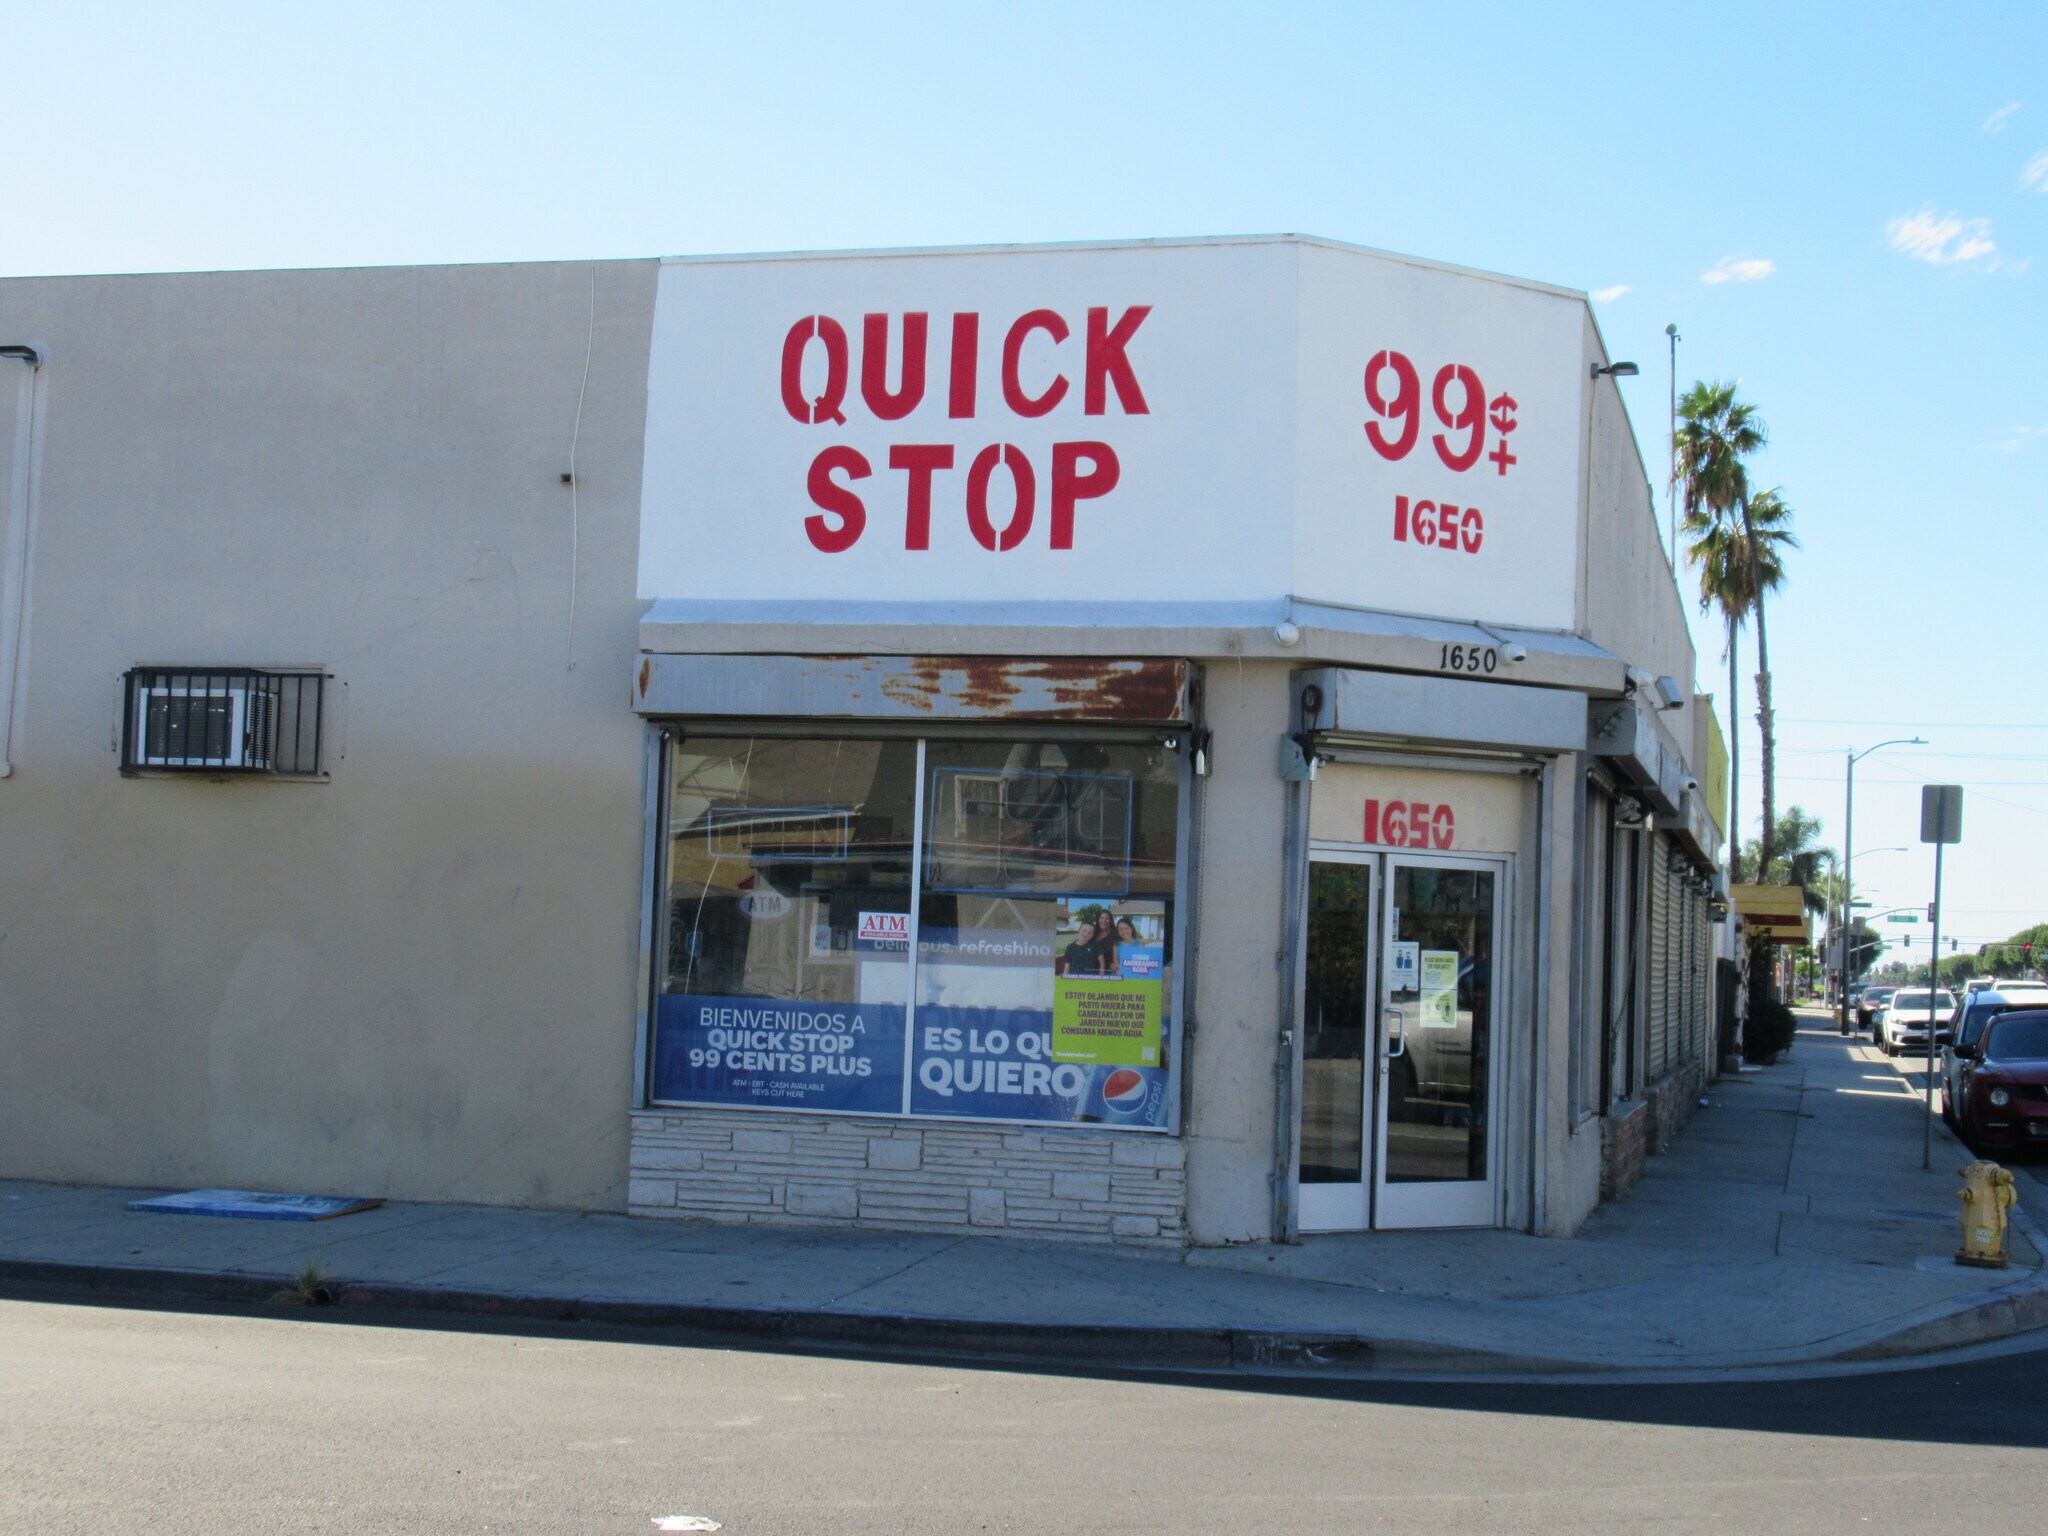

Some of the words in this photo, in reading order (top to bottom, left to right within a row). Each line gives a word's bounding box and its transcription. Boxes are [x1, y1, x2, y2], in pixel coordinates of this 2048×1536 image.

[780, 305, 1154, 427] QUICK
[804, 440, 1121, 553] STOP
[1393, 494, 1484, 554] 1650
[1440, 643, 1497, 673] 1650
[1363, 799, 1455, 850] 1650
[748, 896, 781, 912] ATM
[863, 914, 907, 931] ATM
[1065, 991, 1086, 1000] ESTOY
[1087, 992, 1119, 1001] DEJANDO
[1121, 994, 1134, 1002] QUE
[1078, 1001, 1100, 1009] PASTO
[1101, 1002, 1125, 1010] MUERA
[1127, 1003, 1145, 1011] PARA
[700, 1007, 846, 1033] BIENVENIDOS
[850, 1014, 866, 1034] A
[1078, 1010, 1119, 1019] CAMBIARLO
[1120, 1011, 1133, 1019] POR
[1135, 1012, 1145, 1020] UN
[1106, 1020, 1130, 1028] NUEVO
[1131, 1021, 1145, 1029] QUE
[707, 1028, 785, 1051] QUICK
[788, 1032, 855, 1054] STOP
[924, 1026, 963, 1052] ES
[969, 1029, 1010, 1055] LO
[1061, 1027, 1096, 1036] CONSUMA
[1097, 1028, 1122, 1036] MENOS
[1123, 1029, 1145, 1037] AGUA.
[689, 1049, 721, 1068] 99
[726, 1050, 806, 1074] CENTS
[811, 1055, 872, 1077] PLUS
[732, 1079, 747, 1087] ATM
[752, 1080, 765, 1088] EBT
[769, 1080, 790, 1089] CASH
[790, 1082, 825, 1091] AVAILABLE
[919, 1056, 1087, 1098] QUIERO
[752, 1088, 769, 1096] KEYS
[770, 1089, 785, 1097] CUT
[786, 1090, 805, 1098] HERE
[1145, 1080, 1162, 1123] pepsi
